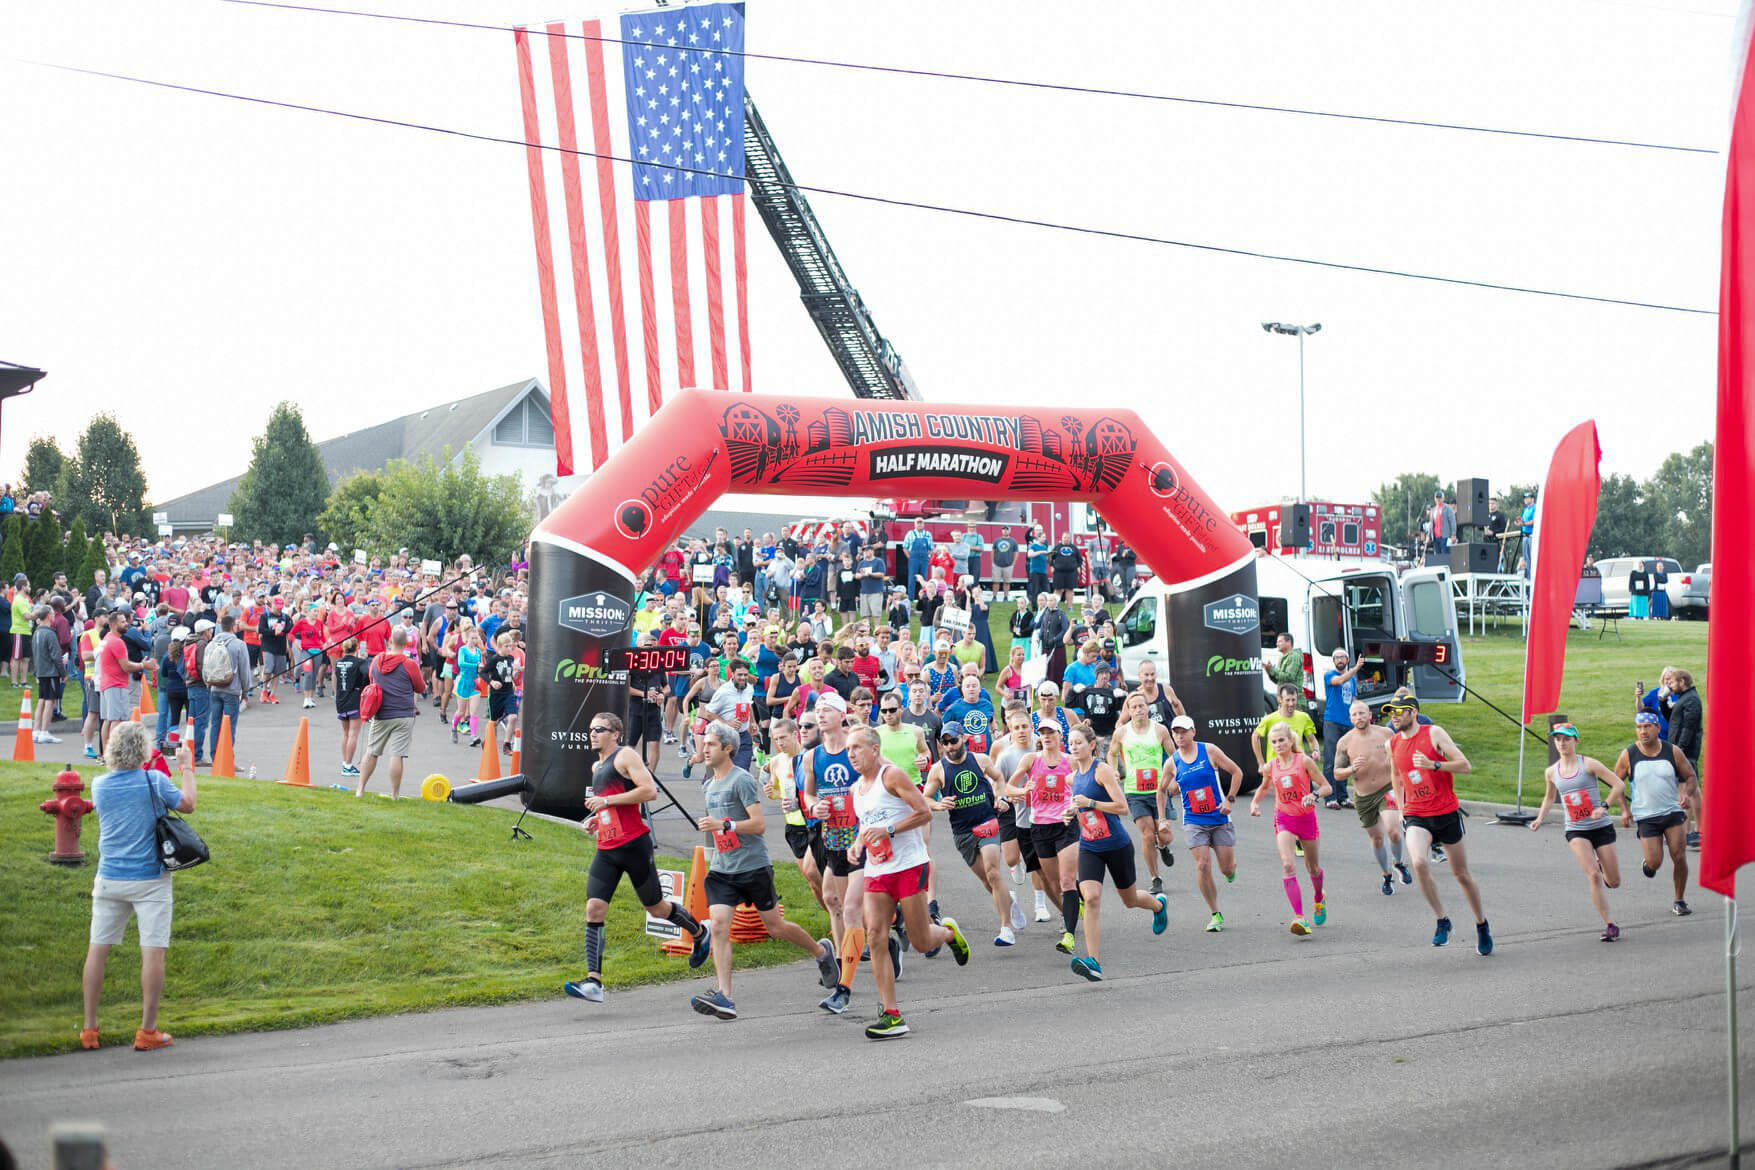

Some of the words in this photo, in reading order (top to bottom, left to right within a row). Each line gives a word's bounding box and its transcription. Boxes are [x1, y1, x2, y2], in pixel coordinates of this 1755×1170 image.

[853, 410, 922, 446] AMISH
[925, 413, 1020, 450] COUNTRY
[876, 453, 914, 473] HALF
[916, 453, 1003, 477] MARATHON
[641, 455, 692, 510] pure
[1173, 486, 1217, 533] pure
[1435, 646, 1445, 664] 3
[1208, 718, 1241, 728] SWISS
[1413, 785, 1431, 798] 162
